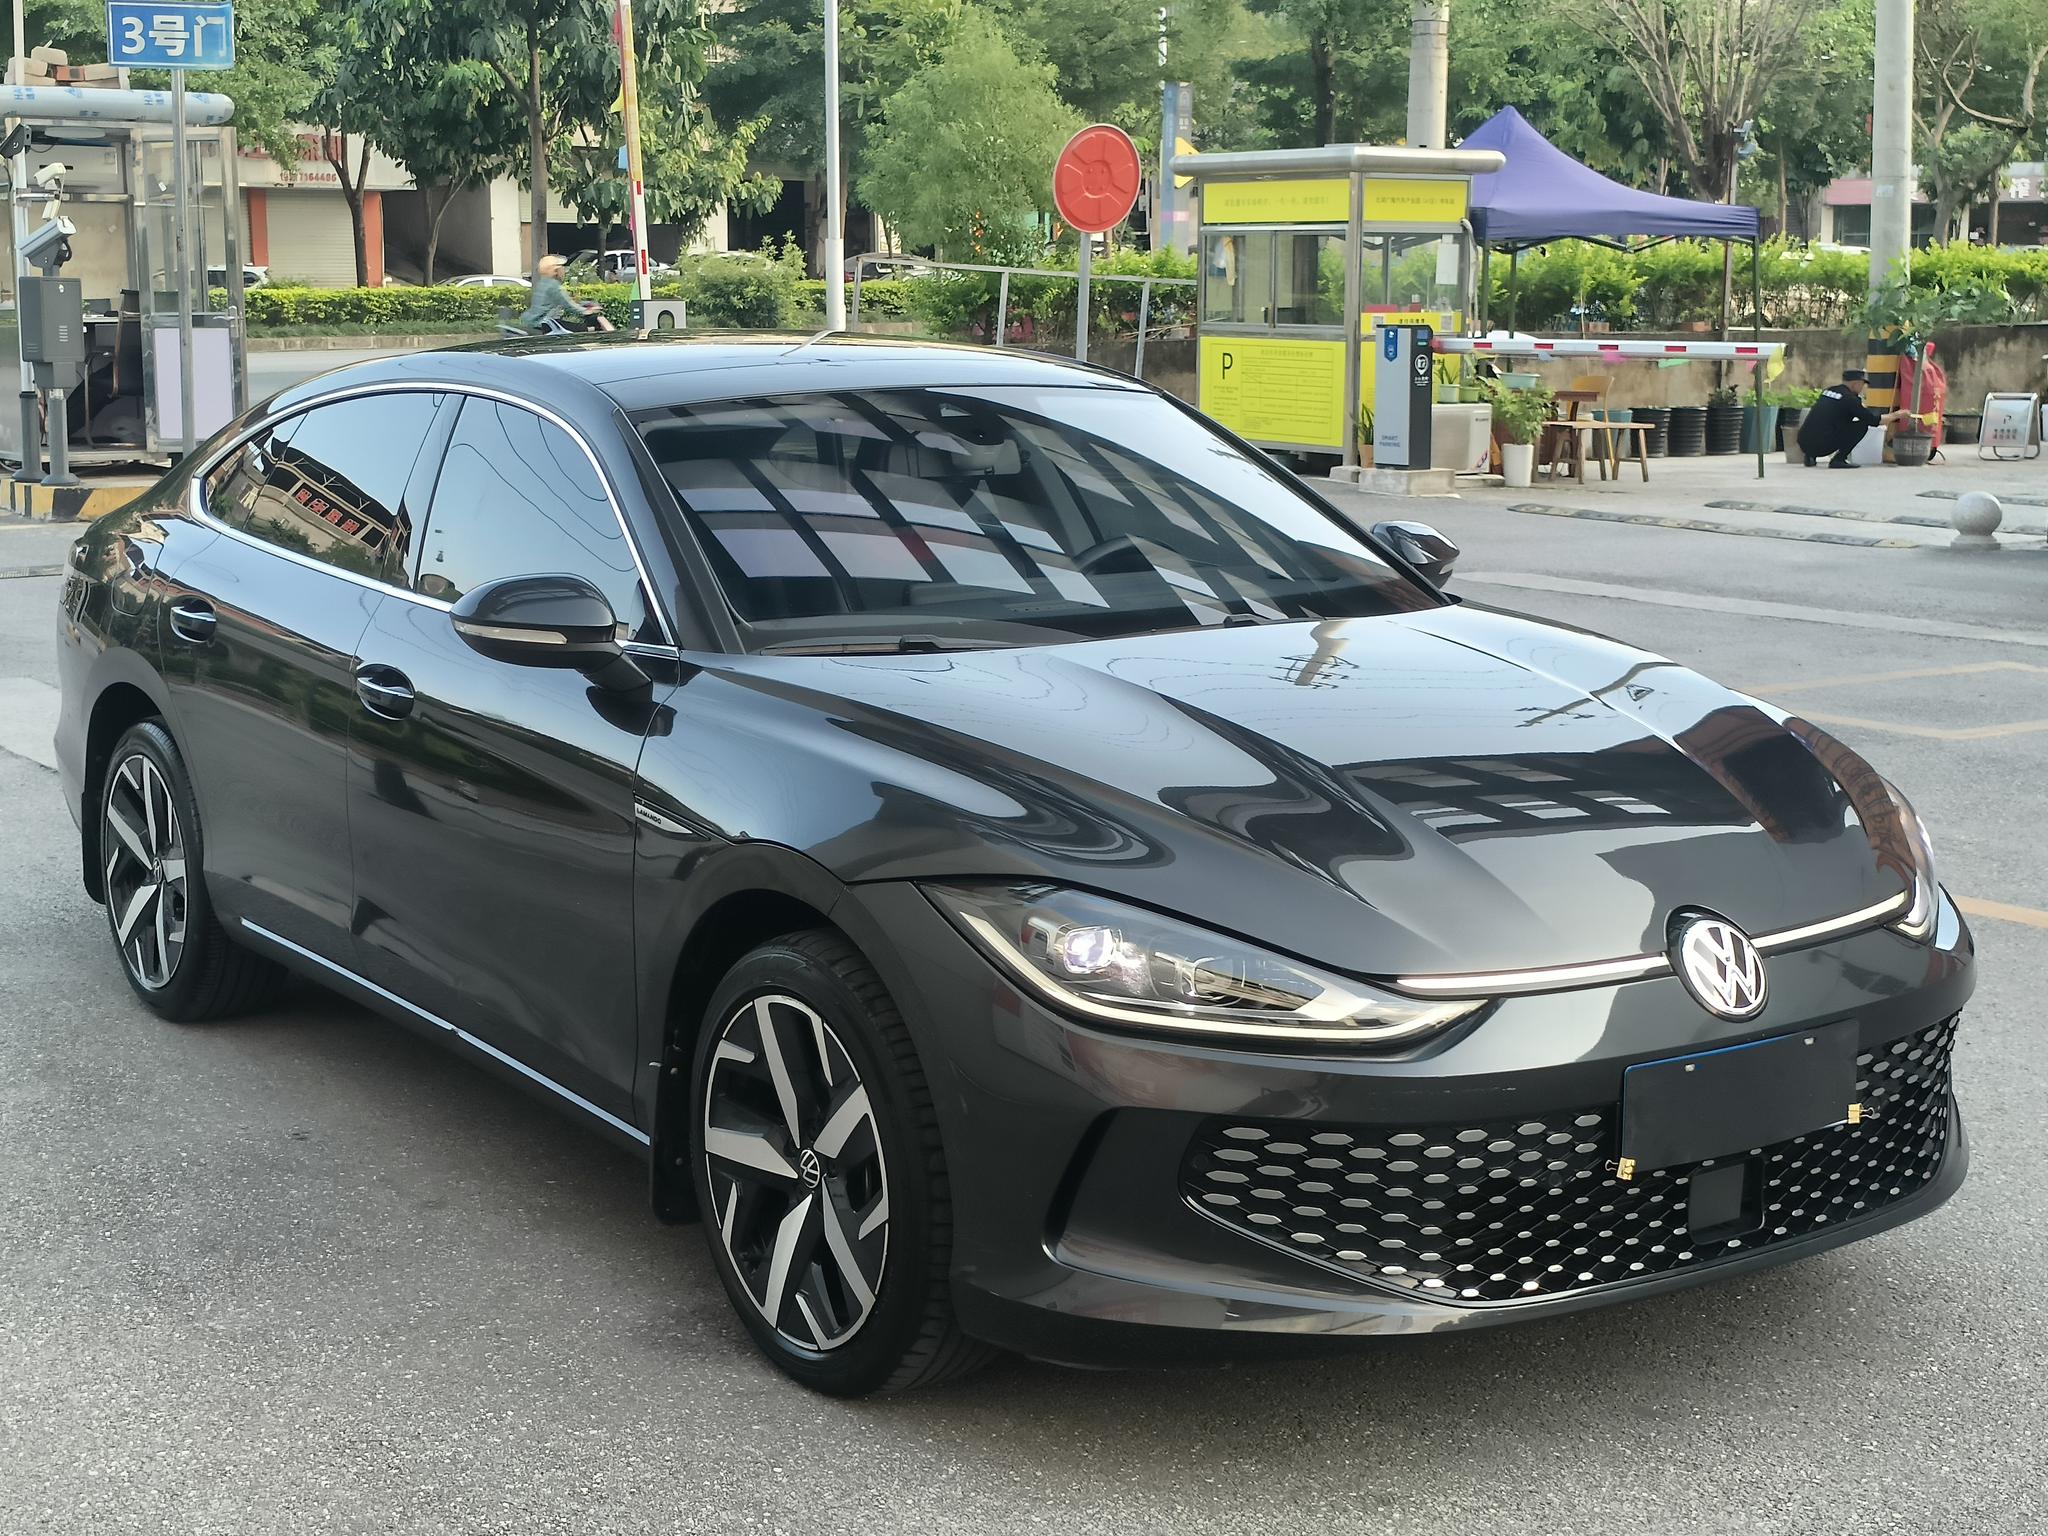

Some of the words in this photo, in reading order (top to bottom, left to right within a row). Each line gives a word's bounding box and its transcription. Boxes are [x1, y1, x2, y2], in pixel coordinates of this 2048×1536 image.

[121, 15, 227, 57] 3号门
[1222, 353, 1233, 380] P
[636, 807, 662, 825] LAMANDO
